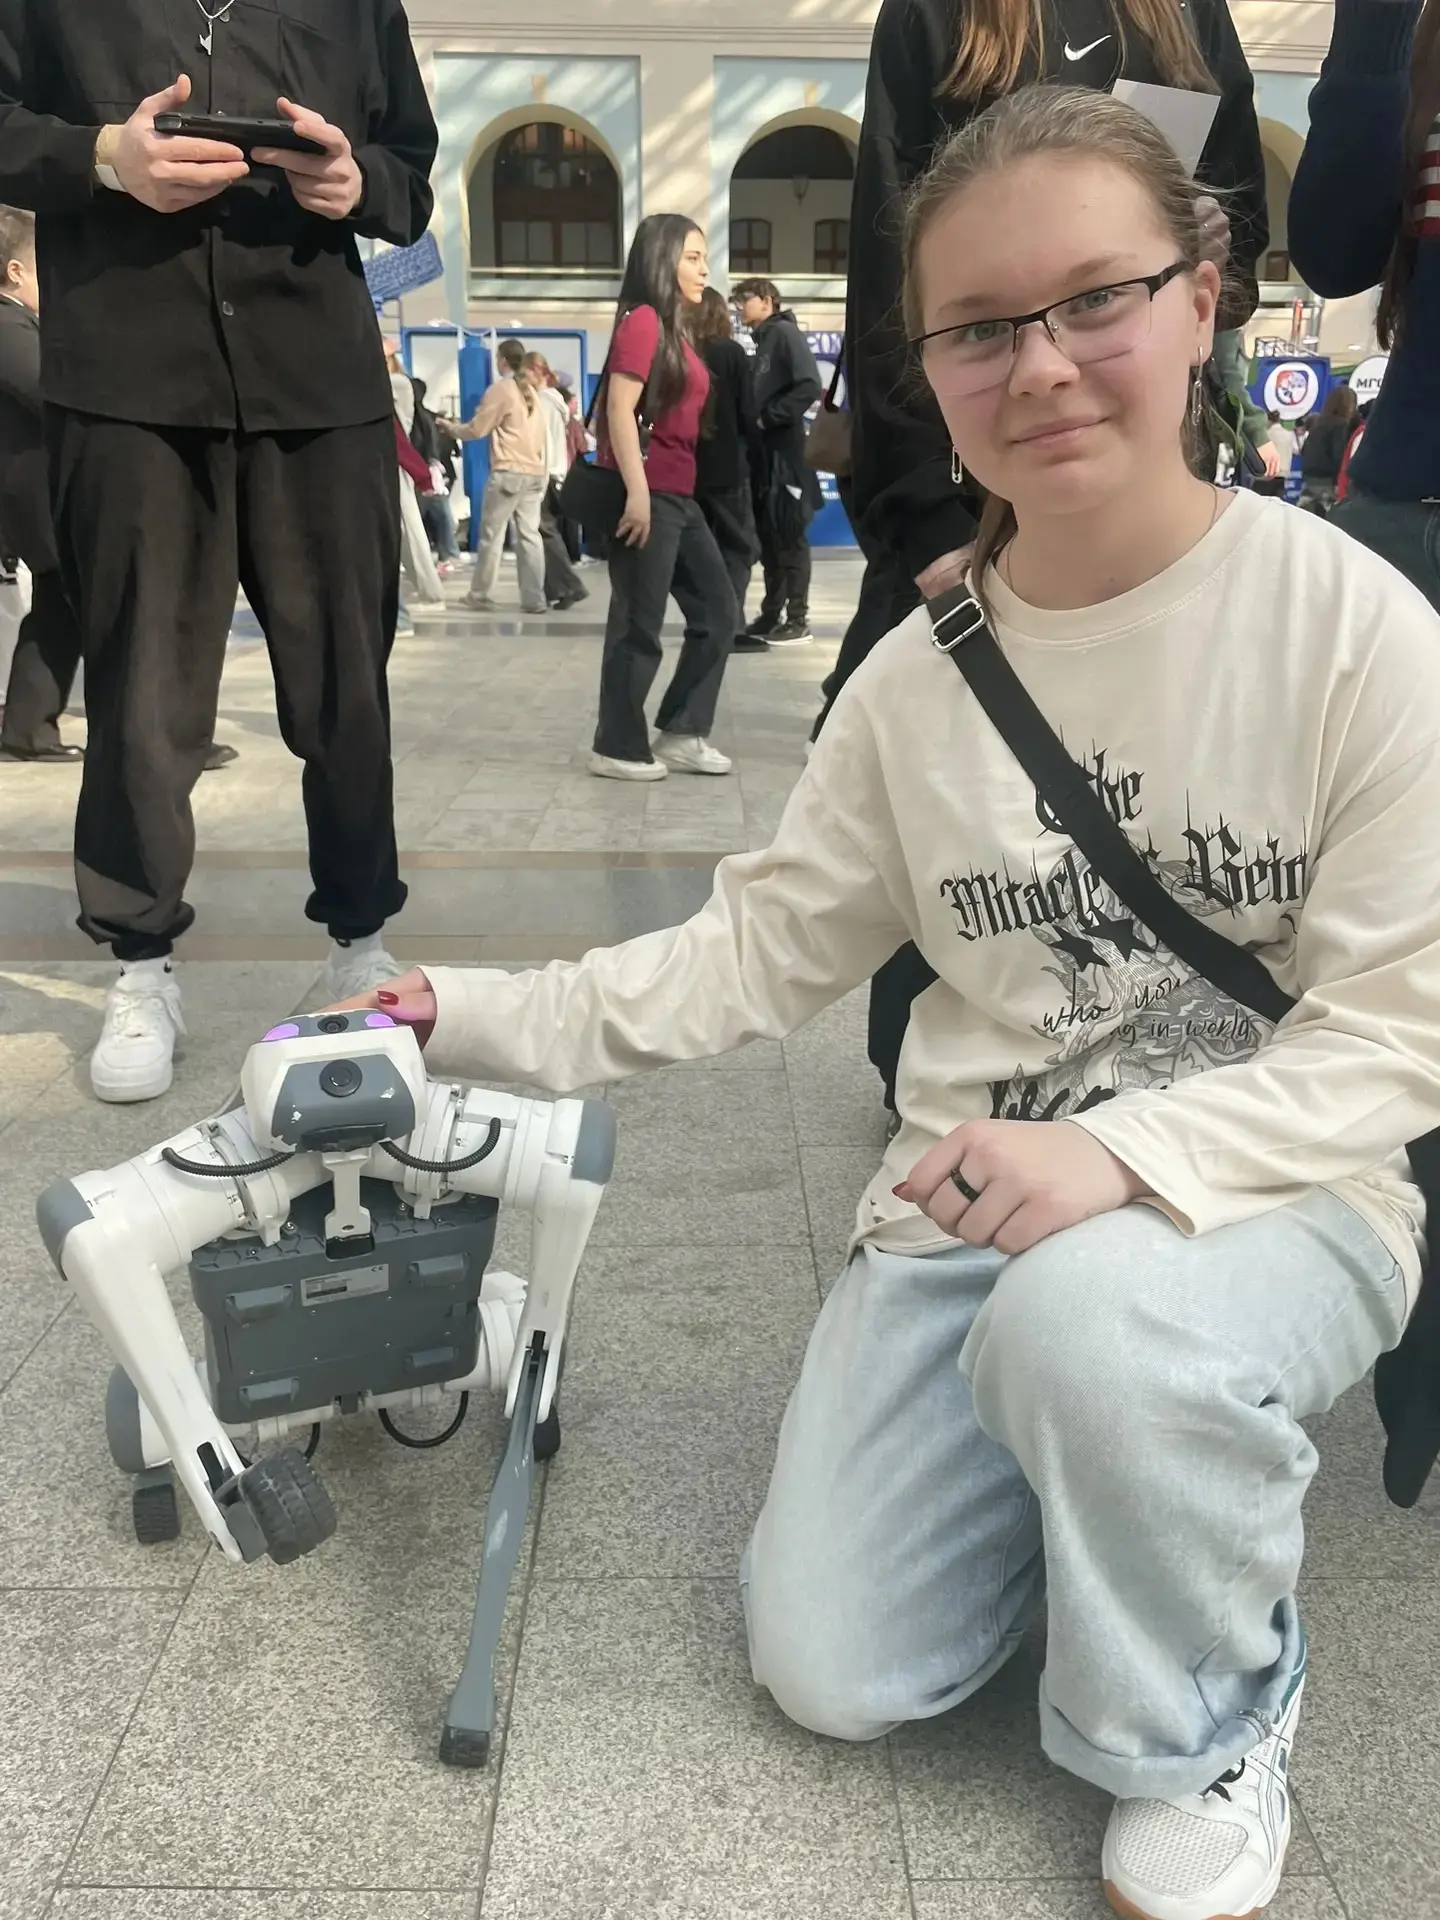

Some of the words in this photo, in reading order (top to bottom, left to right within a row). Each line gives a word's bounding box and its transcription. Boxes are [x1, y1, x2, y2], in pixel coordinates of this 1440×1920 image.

[1035, 734, 1145, 838] he
[940, 848, 1104, 941] Miracle
[1180, 790, 1308, 922] Bein
[1043, 968, 1111, 1032] who
[1150, 1018, 1171, 1039] in
[1185, 1008, 1250, 1041] world
